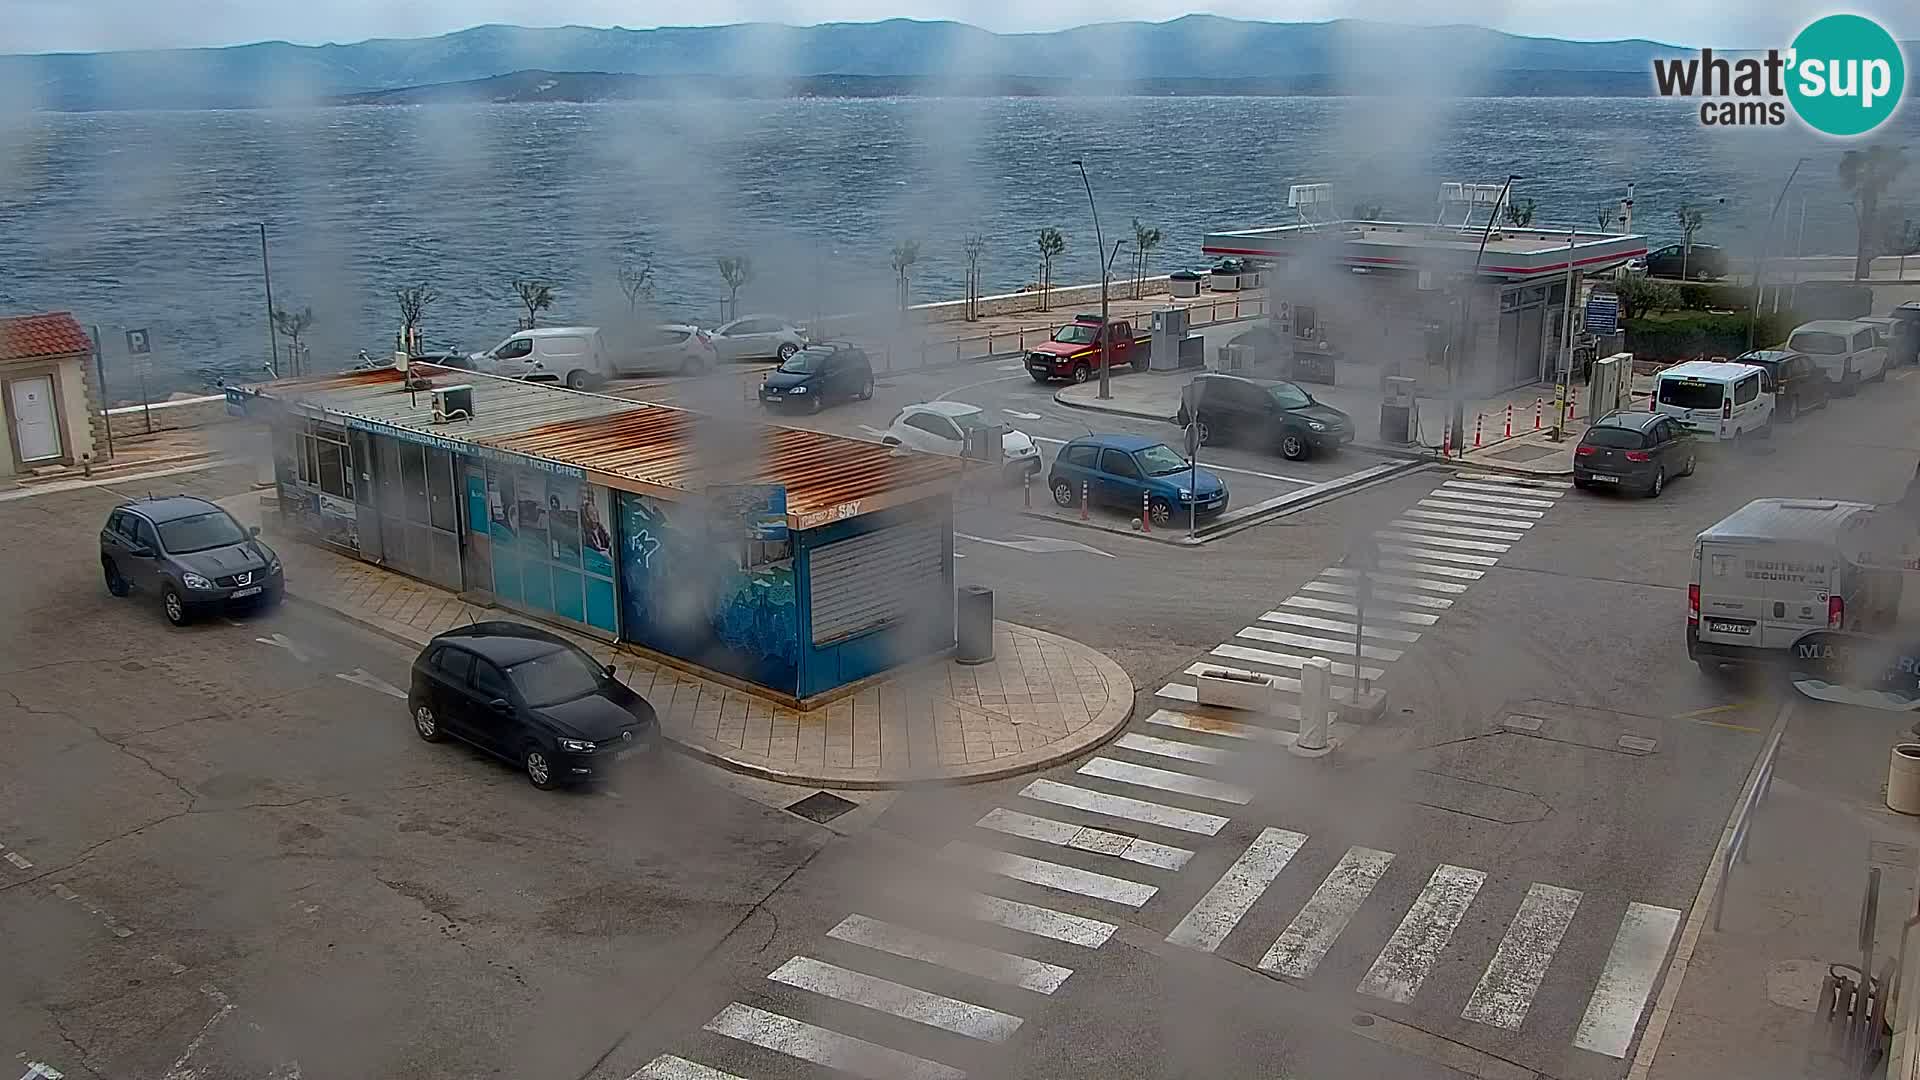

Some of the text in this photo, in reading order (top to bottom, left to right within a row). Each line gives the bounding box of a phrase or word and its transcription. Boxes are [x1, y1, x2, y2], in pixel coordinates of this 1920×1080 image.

[437, 438, 468, 453] POSTAJA
[529, 457, 555, 473] TICKET
[555, 463, 583, 479] OFFICE
[1745, 570, 1806, 584] SECURITY
